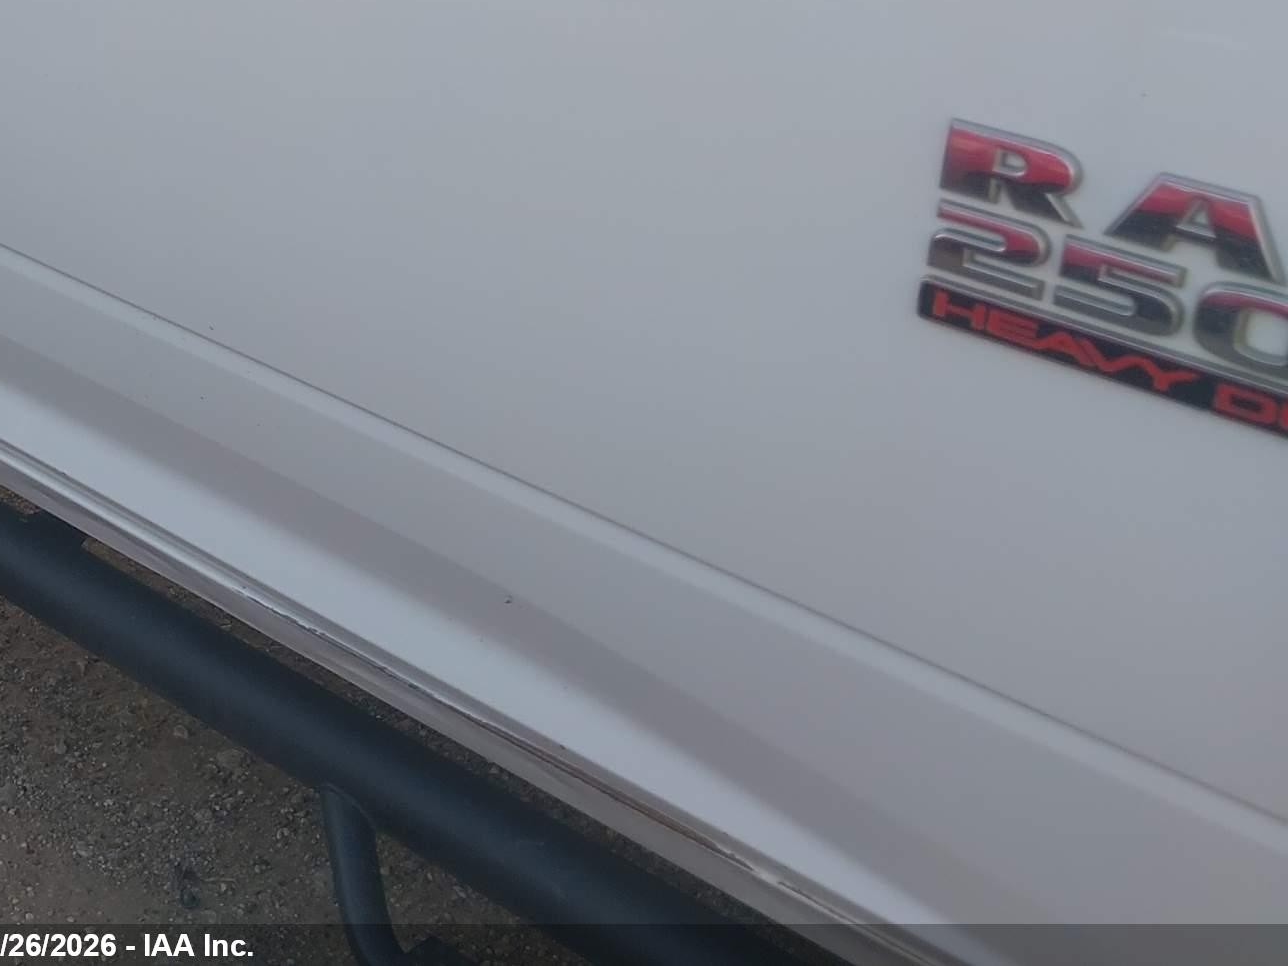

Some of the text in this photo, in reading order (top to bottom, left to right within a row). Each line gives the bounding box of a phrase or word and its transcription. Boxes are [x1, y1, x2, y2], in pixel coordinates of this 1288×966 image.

[939, 117, 1287, 287] RA
[933, 290, 1288, 432] HEAVY D
